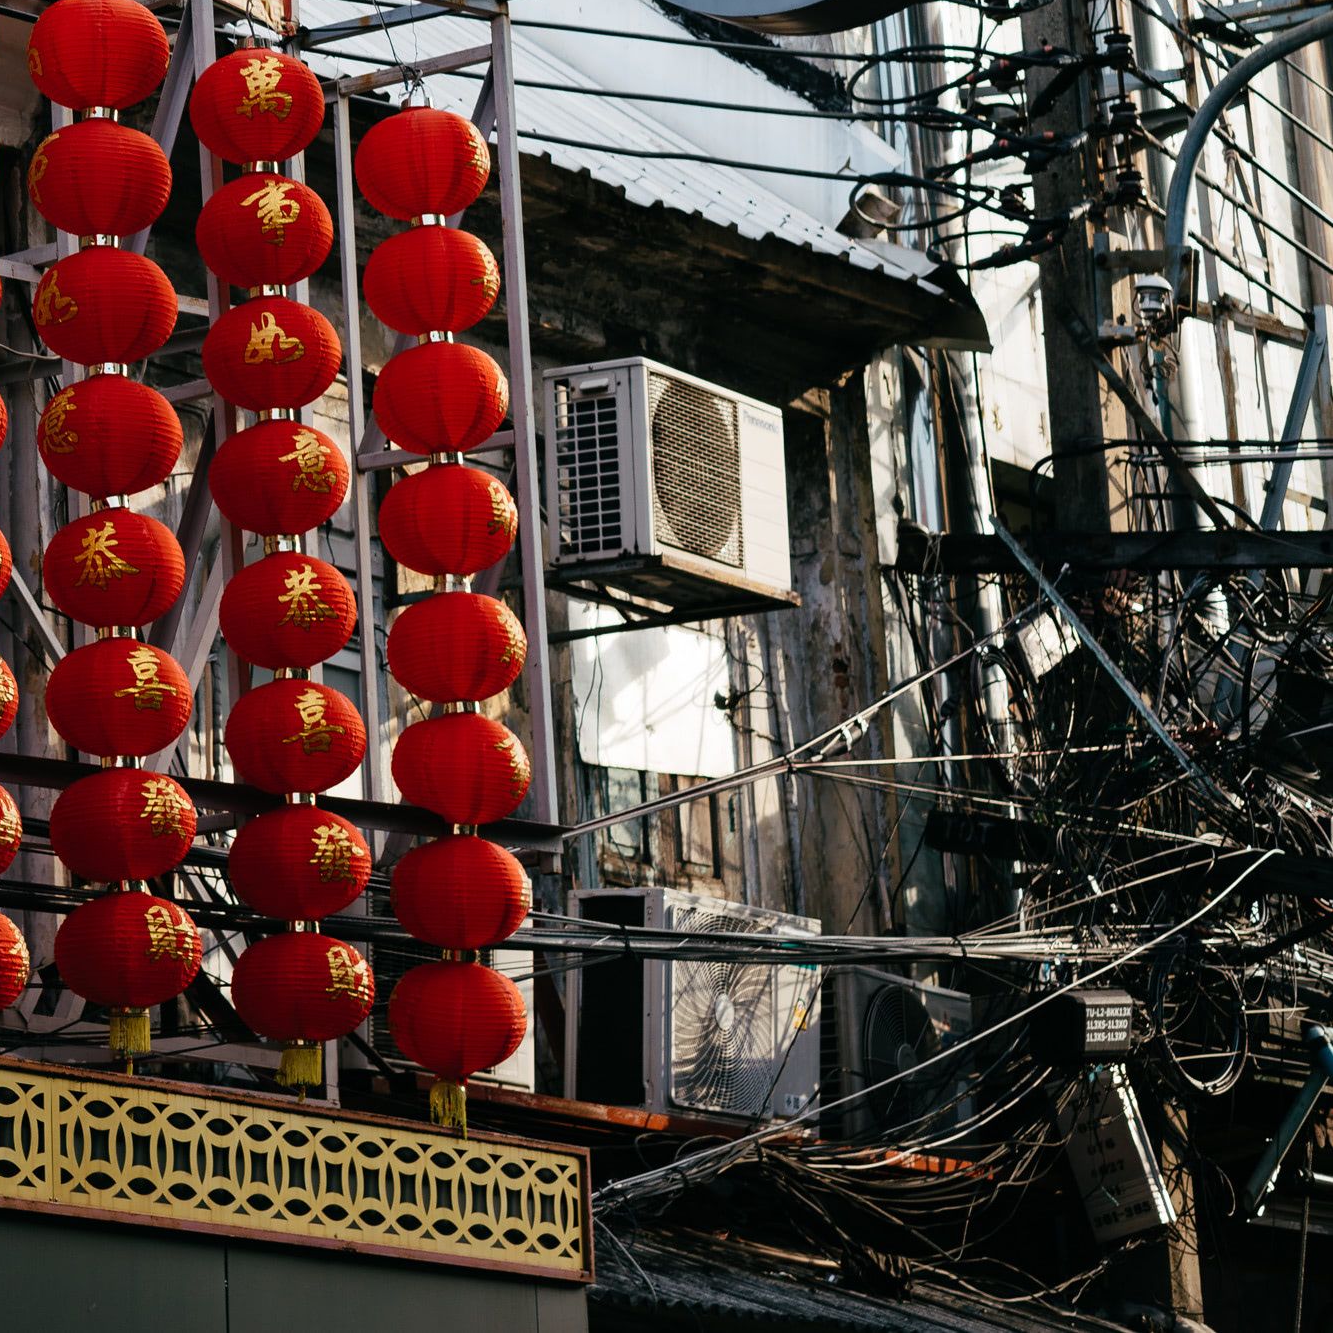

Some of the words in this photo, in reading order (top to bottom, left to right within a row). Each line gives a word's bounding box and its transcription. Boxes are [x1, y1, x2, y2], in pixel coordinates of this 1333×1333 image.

[234, 54, 294, 123] 萬
[239, 178, 303, 249] 事
[242, 310, 306, 366] 如
[277, 427, 338, 494] 意
[73, 520, 142, 591] 恭
[276, 563, 340, 633] 恭
[113, 644, 179, 713] 喜
[281, 686, 347, 757] 喜
[138, 777, 194, 842] 發
[308, 821, 366, 887] 發
[143, 903, 200, 972] 財
[325, 944, 372, 1009] 財
